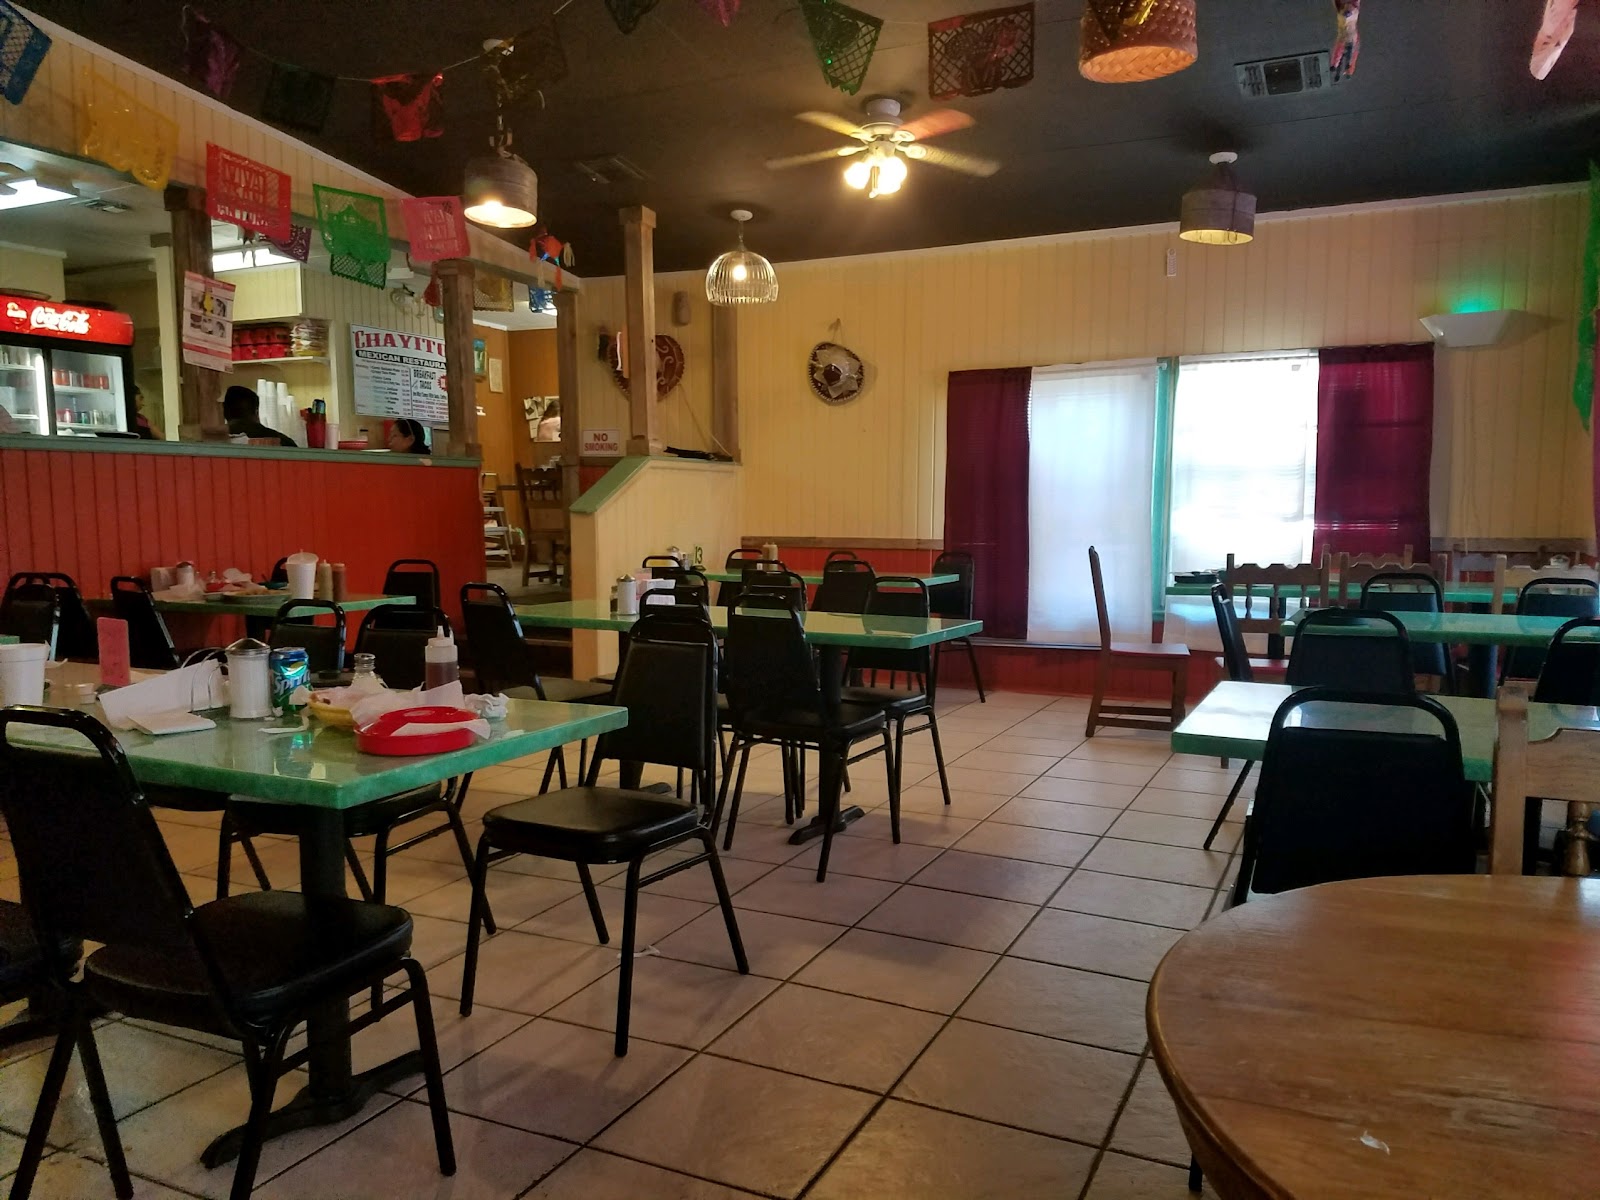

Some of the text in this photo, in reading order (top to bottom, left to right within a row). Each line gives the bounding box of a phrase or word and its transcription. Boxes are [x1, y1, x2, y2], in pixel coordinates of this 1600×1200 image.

[30, 306, 90, 334] Coca-Cola
[358, 350, 401, 362] MEXICAN
[593, 433, 609, 441] NO
[584, 442, 618, 452] SMOKING
[694, 546, 703, 565] 13
